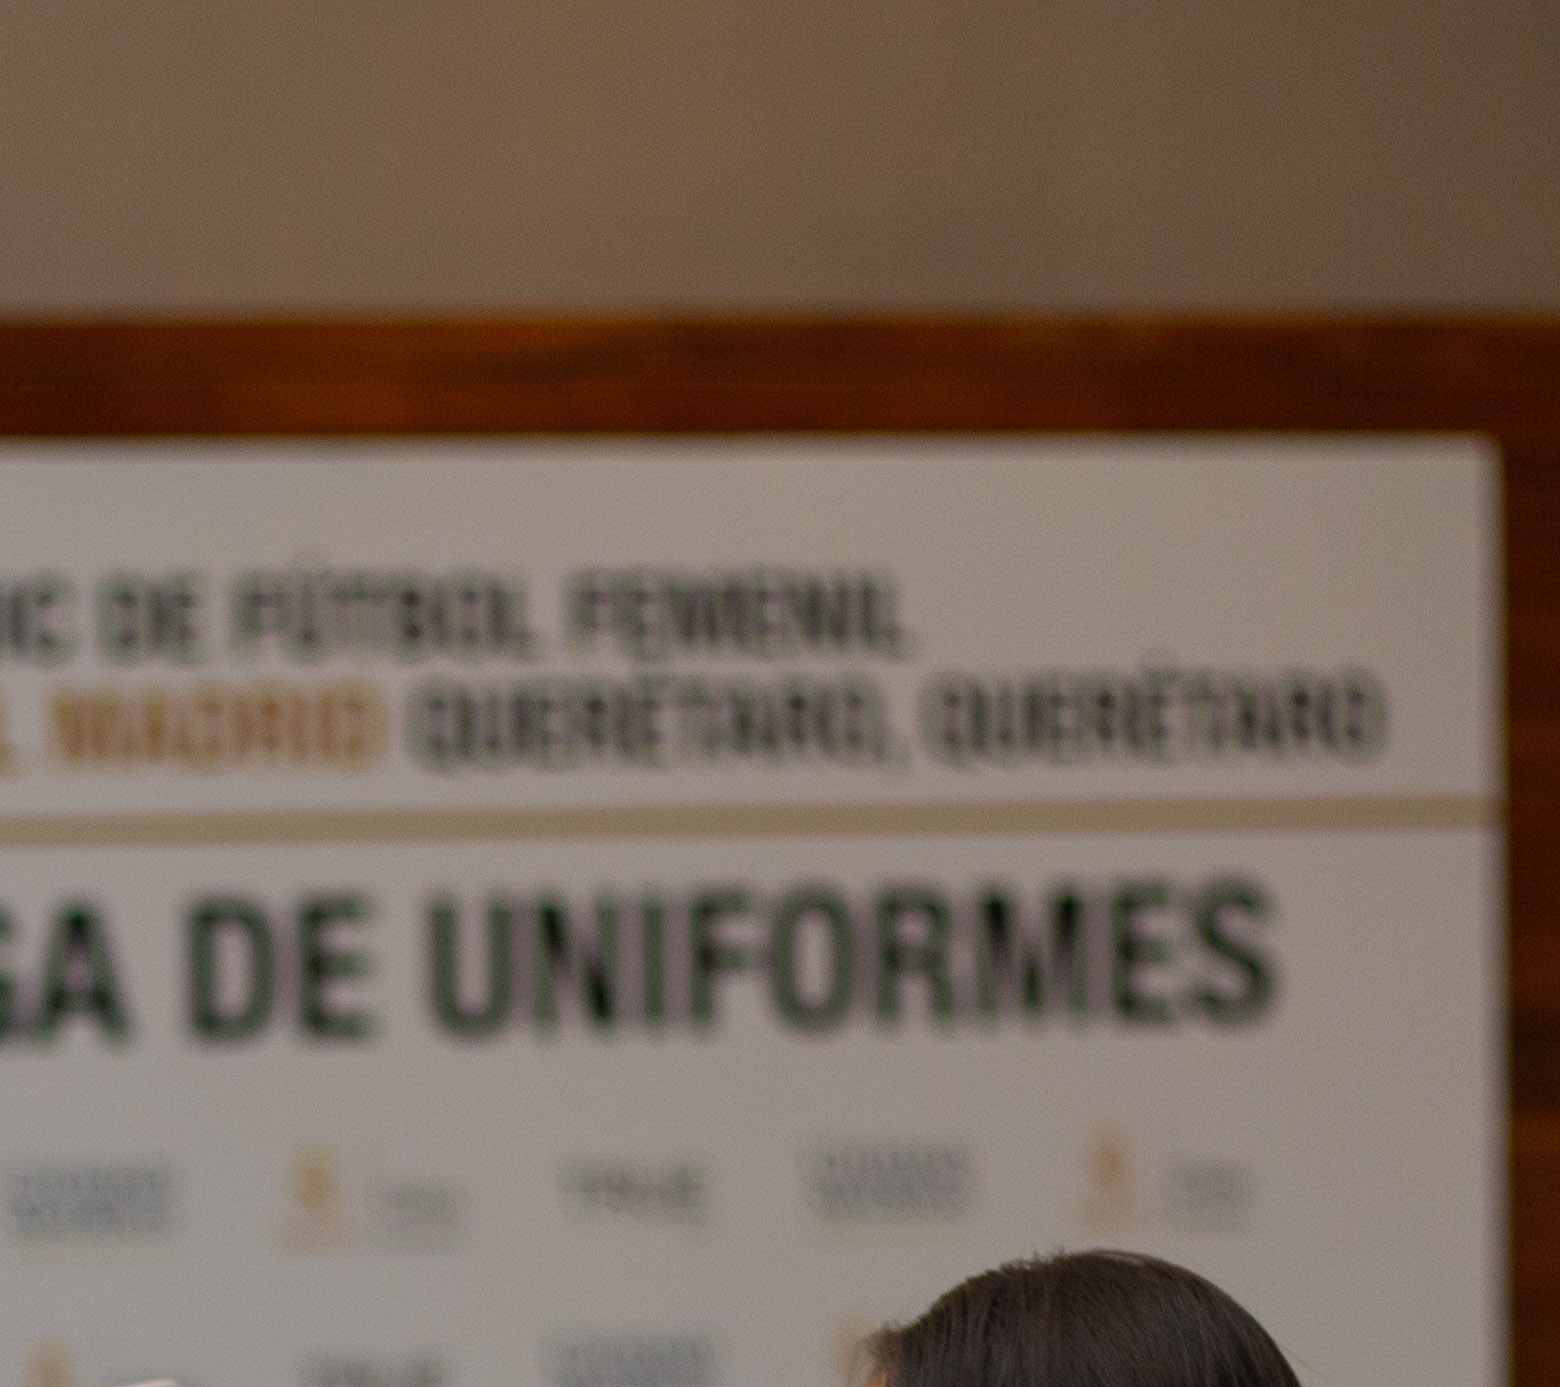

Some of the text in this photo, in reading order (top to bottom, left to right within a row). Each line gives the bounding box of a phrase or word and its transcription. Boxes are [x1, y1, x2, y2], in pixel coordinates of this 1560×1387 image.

[95, 568, 208, 666] DE
[228, 545, 536, 665] FÚTBOL
[564, 560, 914, 662] FEMENIL
[46, 676, 386, 778] MADRID
[405, 670, 910, 778] QUERÉTARO,
[918, 652, 1388, 770] QUERÉTARO
[186, 890, 378, 1050] DE
[424, 873, 1280, 1046] UNIFORMES
